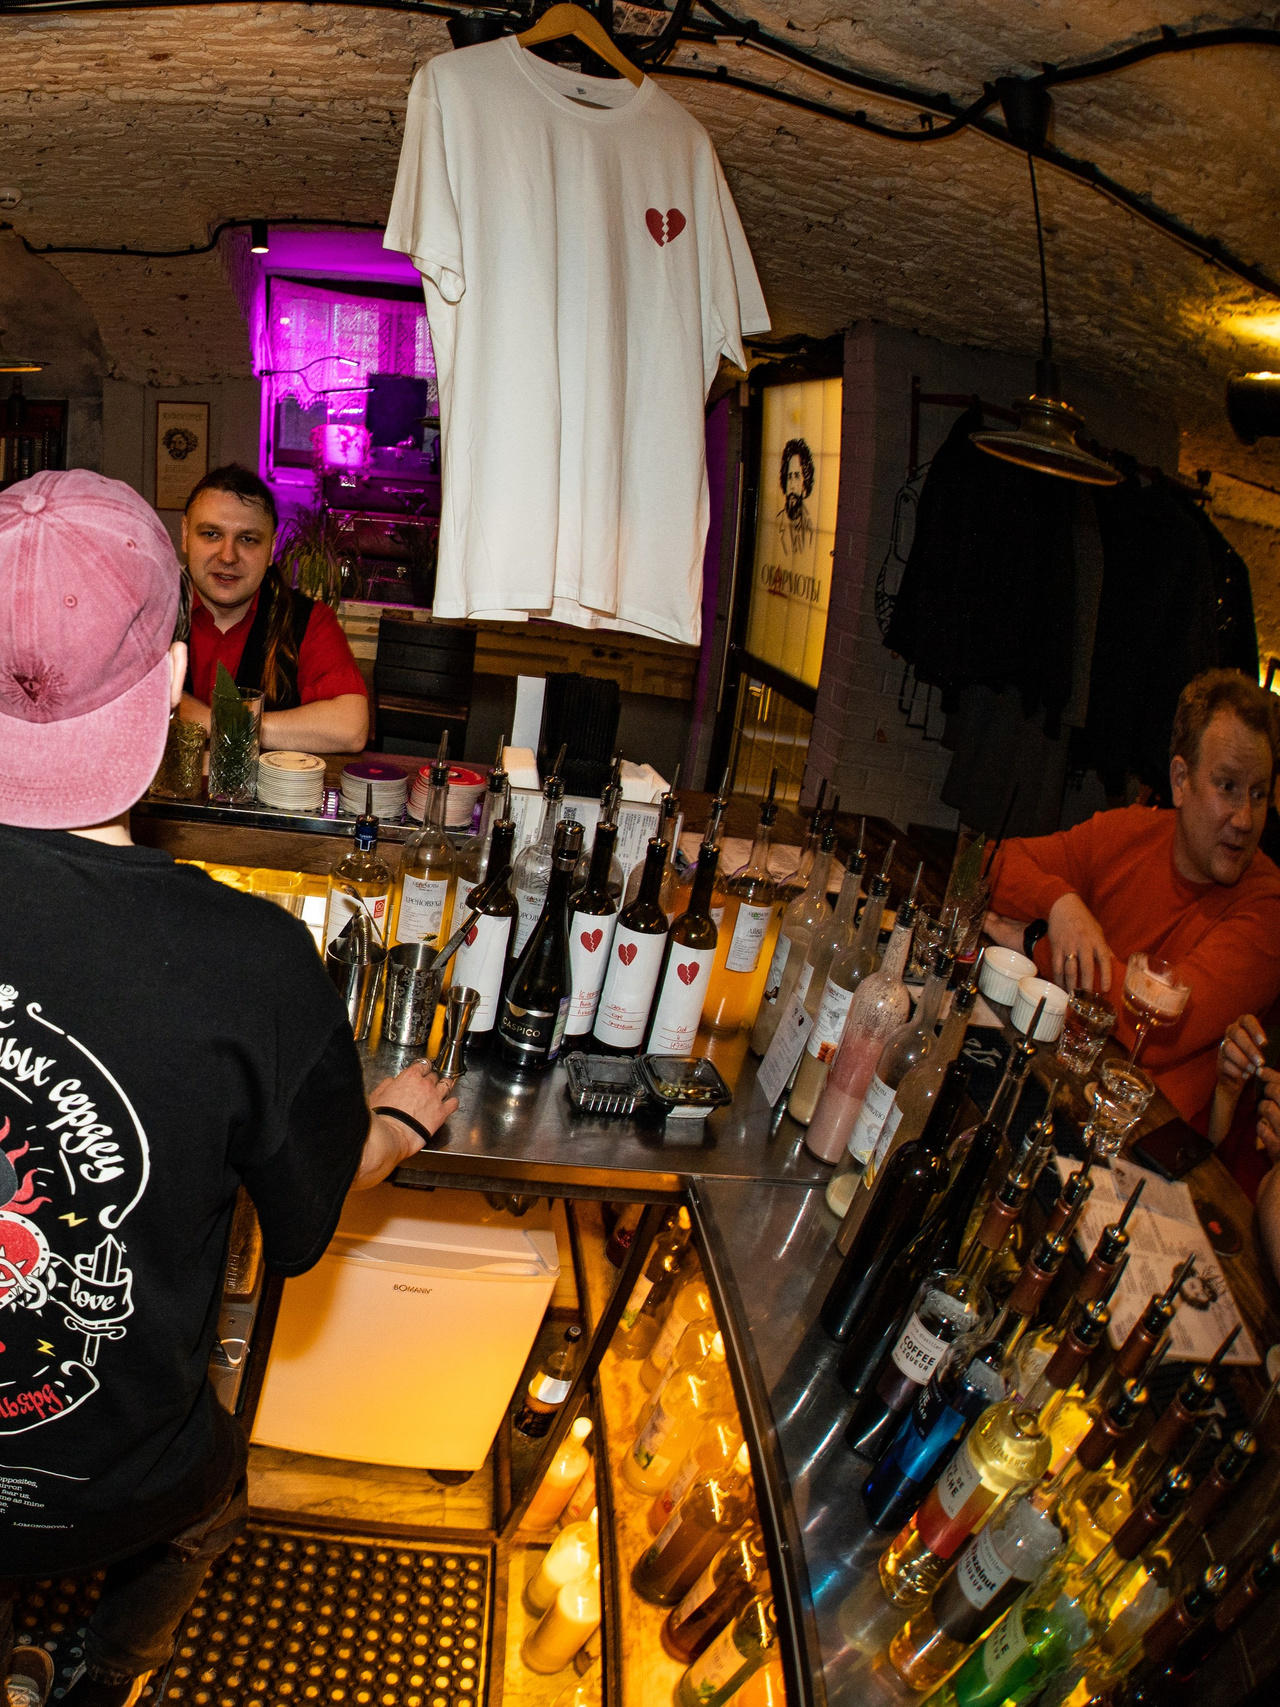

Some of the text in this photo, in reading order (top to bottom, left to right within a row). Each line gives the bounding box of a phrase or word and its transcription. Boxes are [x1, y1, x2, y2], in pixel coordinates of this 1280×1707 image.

[502, 1016, 540, 1038] CASPICO
[70, 1279, 117, 1311] love
[899, 1341, 929, 1372] LIQUEUR
[904, 1335, 936, 1366] COFFEE
